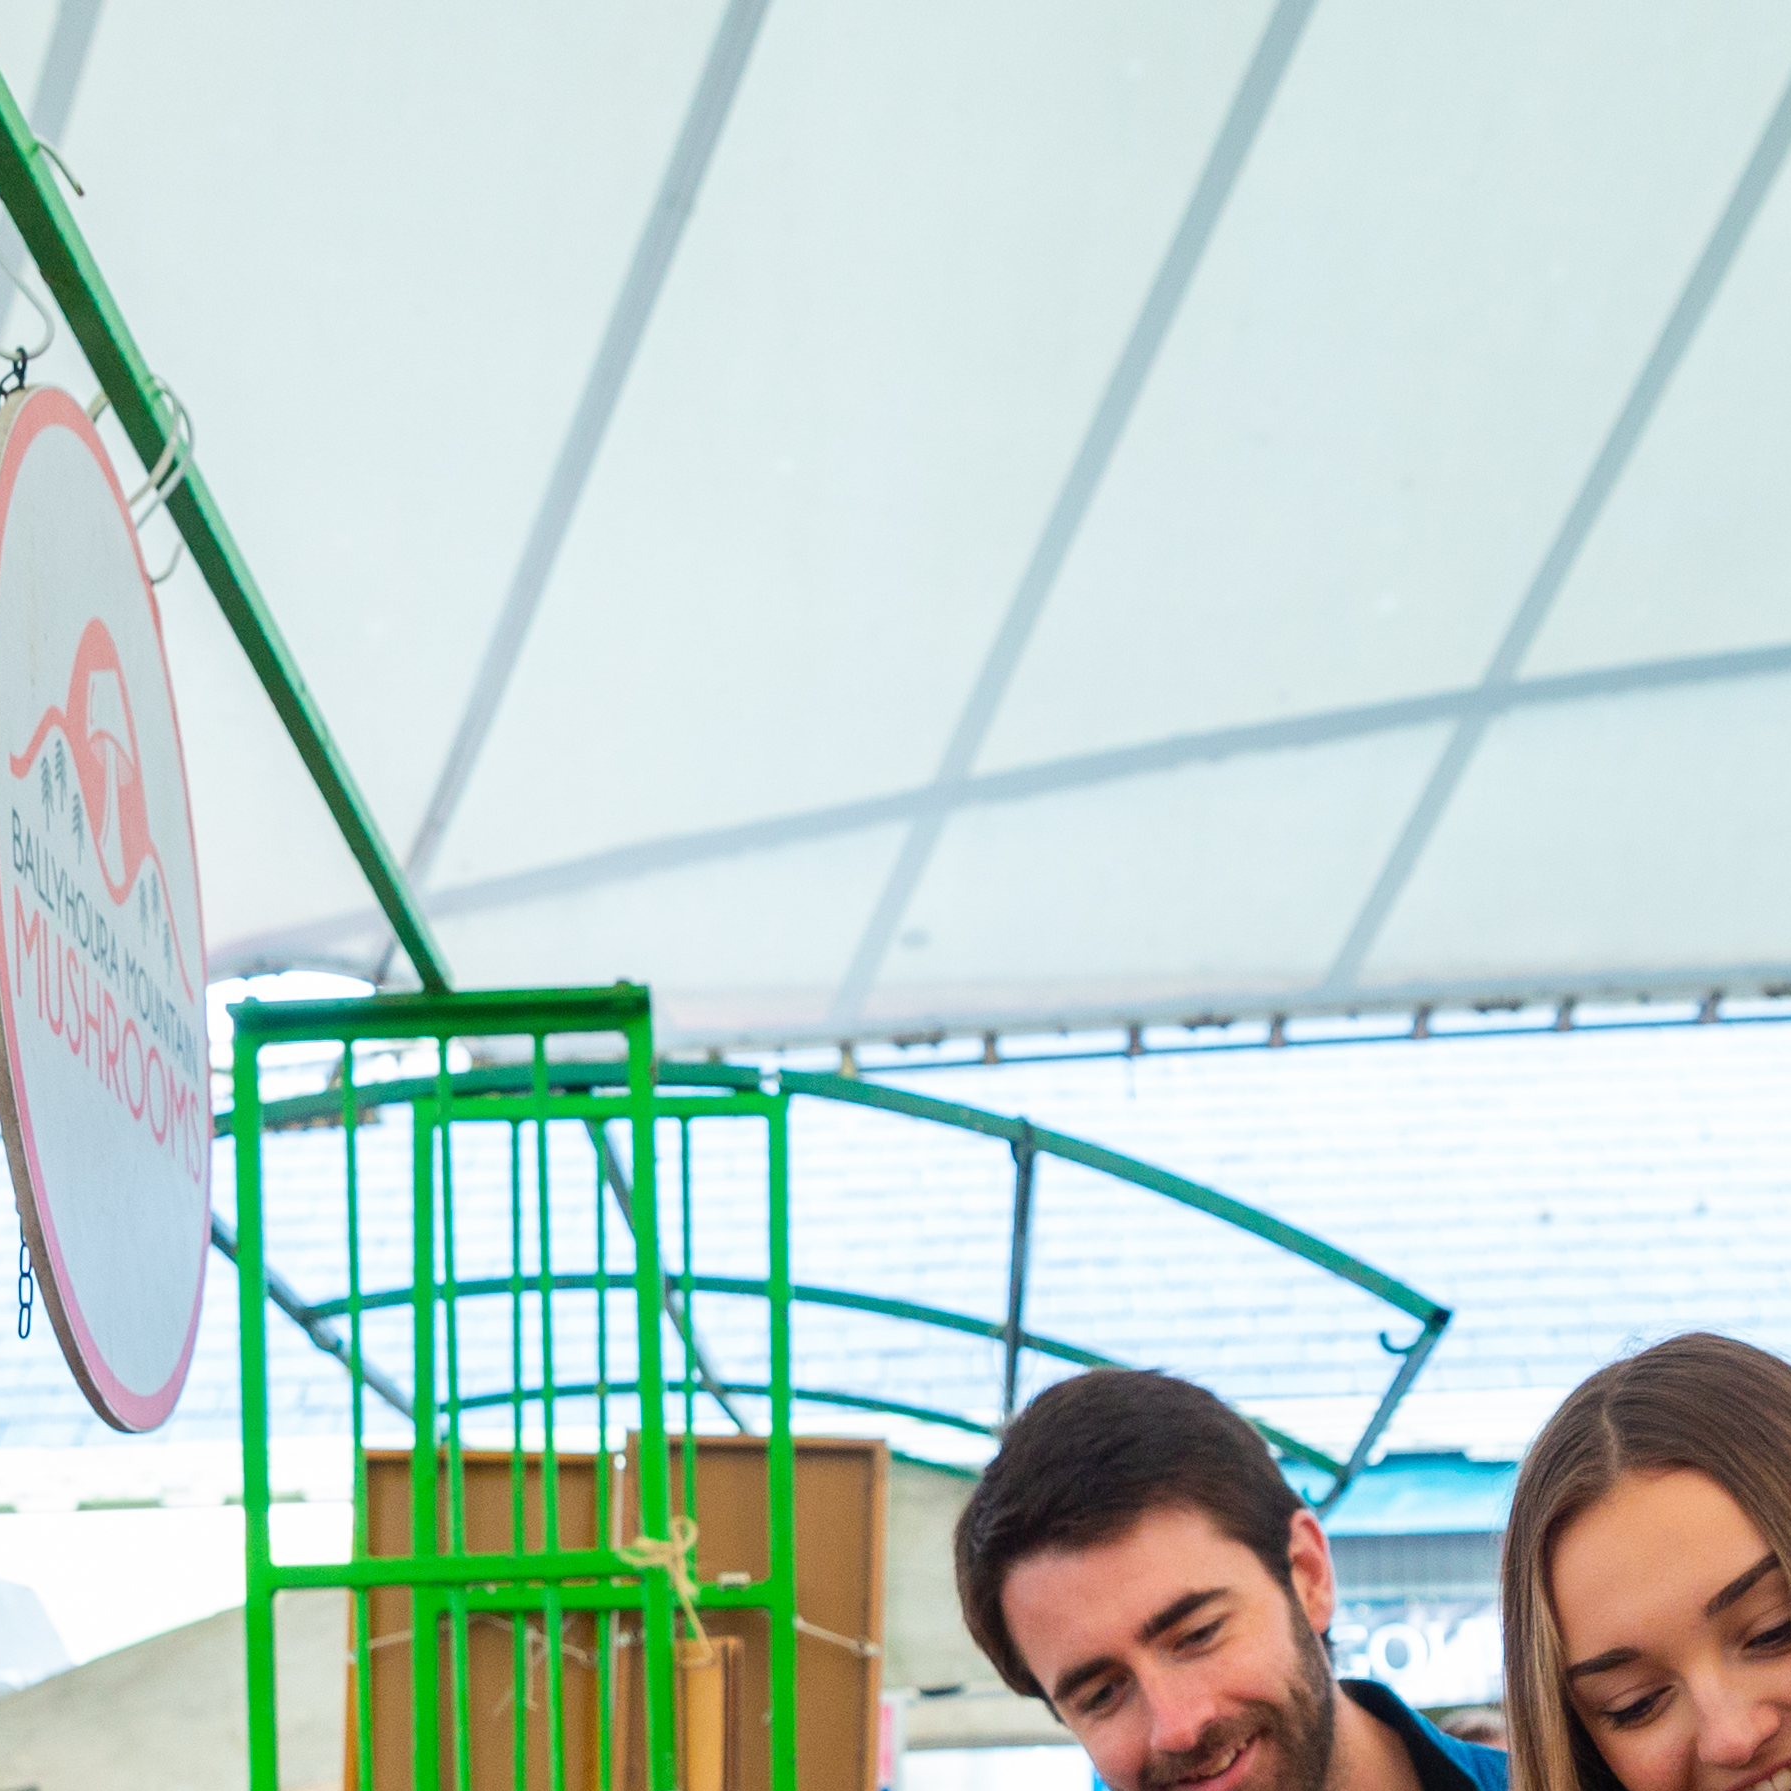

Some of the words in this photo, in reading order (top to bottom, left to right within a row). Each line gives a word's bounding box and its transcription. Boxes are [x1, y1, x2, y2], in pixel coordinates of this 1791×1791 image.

[12, 807, 121, 990] BALLYHOURA
[125, 946, 199, 1083] MOUNTAIN
[14, 884, 202, 1185] MUSHROOMS
